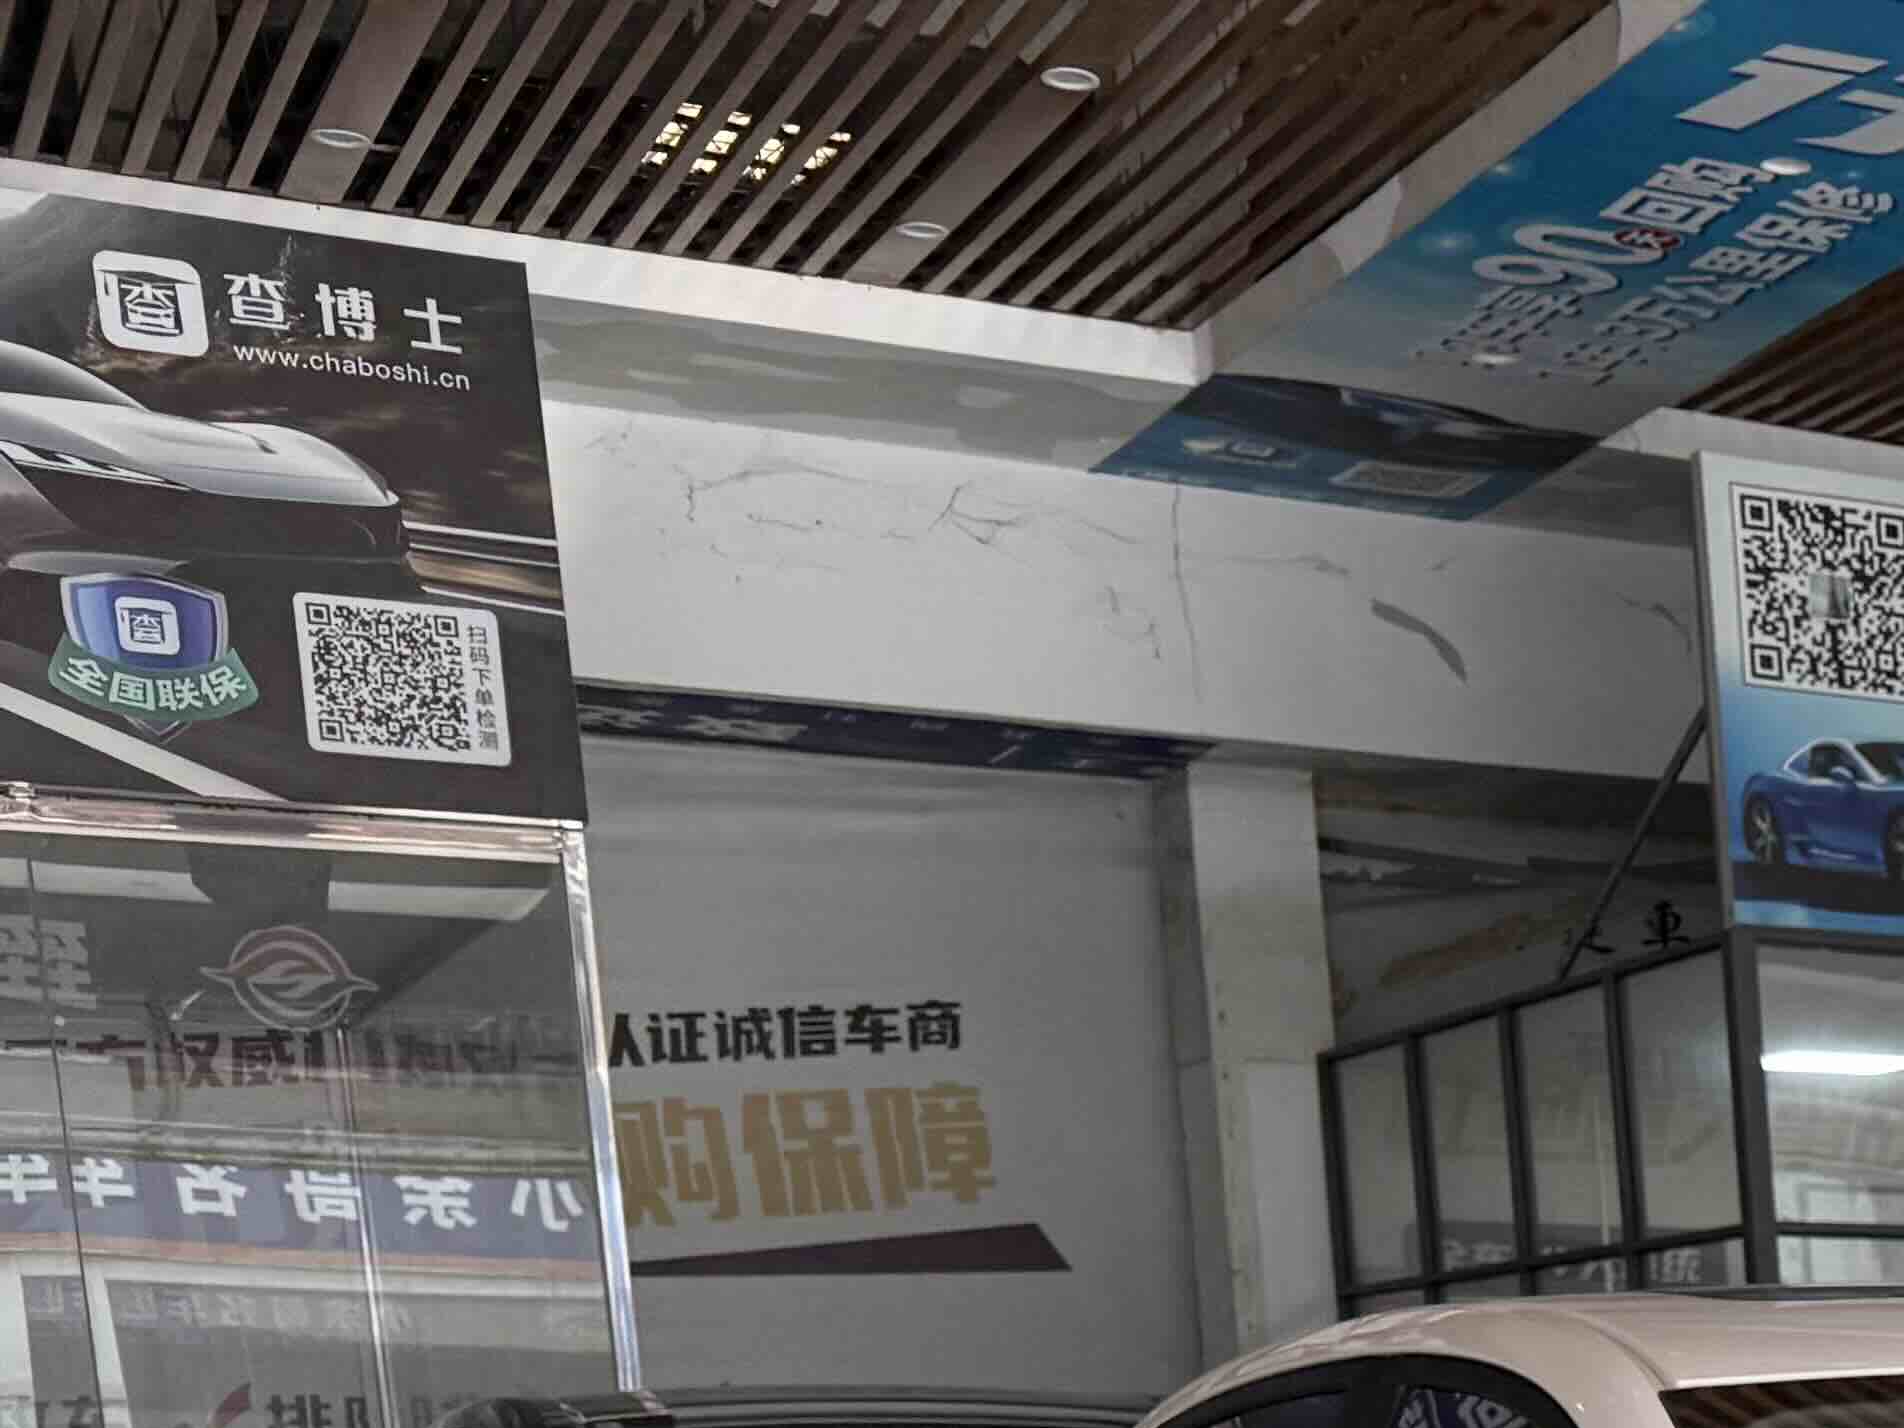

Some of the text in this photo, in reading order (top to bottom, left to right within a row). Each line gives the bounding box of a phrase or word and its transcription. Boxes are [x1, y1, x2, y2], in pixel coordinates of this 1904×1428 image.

[224, 272, 464, 355] 查博士
[233, 343, 470, 391] www.chaboshi.cn
[61, 656, 248, 712] 全国联保
